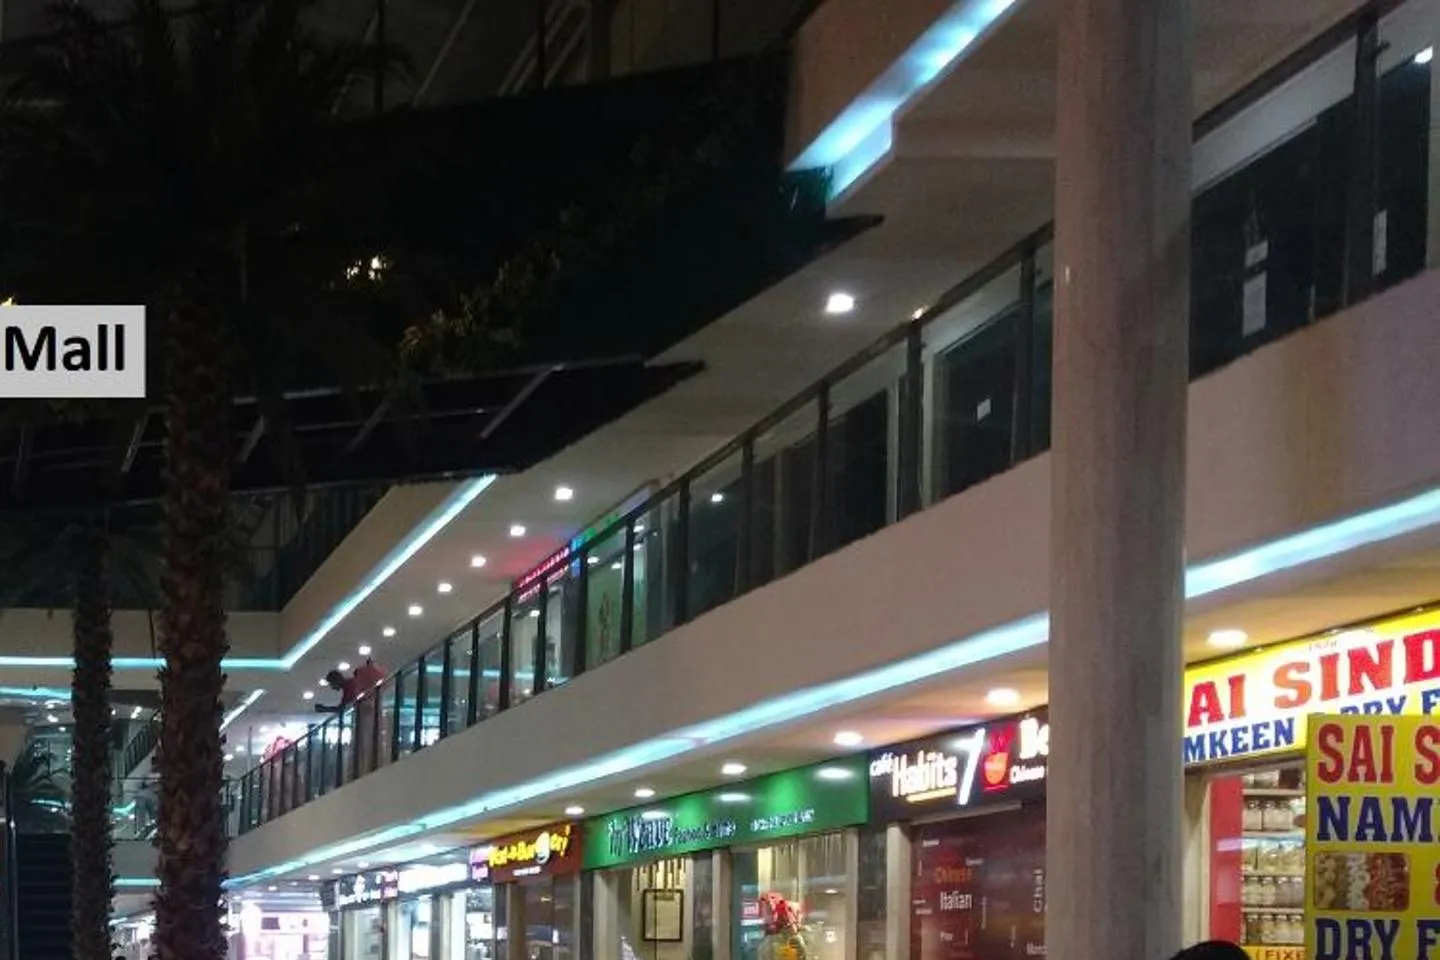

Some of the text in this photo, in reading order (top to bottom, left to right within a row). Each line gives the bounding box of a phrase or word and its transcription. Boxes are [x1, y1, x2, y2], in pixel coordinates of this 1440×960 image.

[1316, 723, 1395, 784] SAI
[1317, 796, 1440, 842] NAM
[940, 890, 972, 910] Italian
